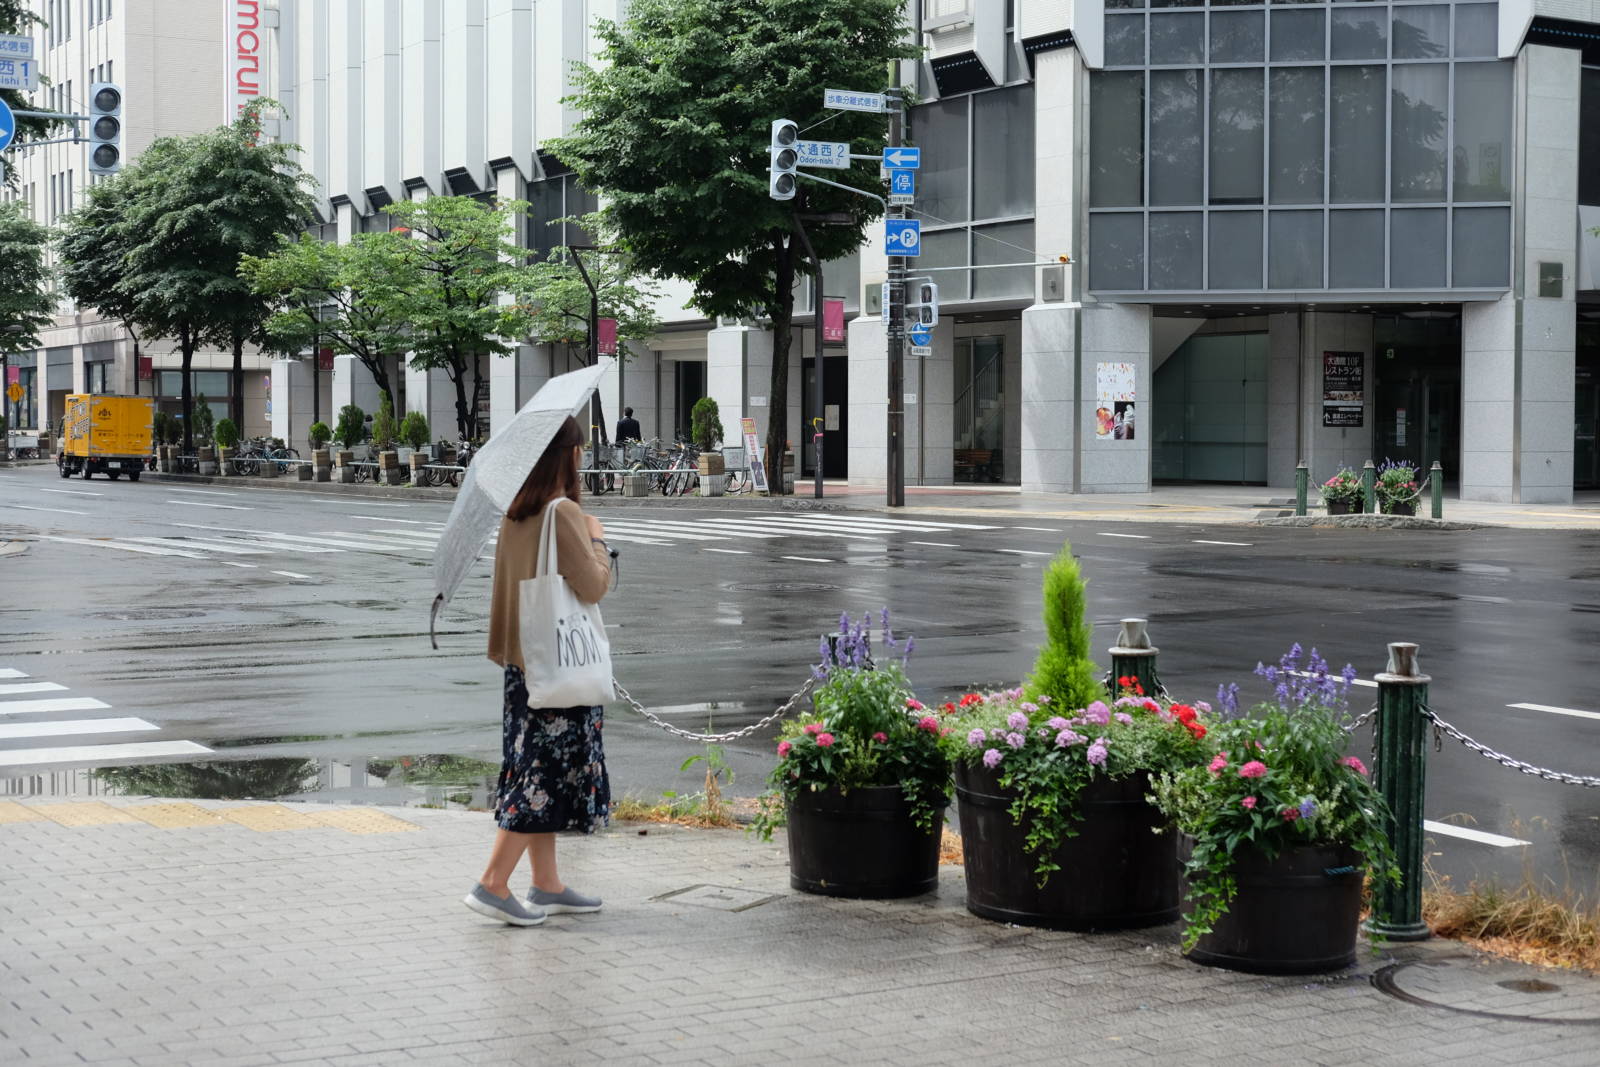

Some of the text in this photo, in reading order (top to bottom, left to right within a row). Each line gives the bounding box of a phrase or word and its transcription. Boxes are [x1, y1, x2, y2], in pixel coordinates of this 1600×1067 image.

[796, 143, 845, 158] 大通西 2
[799, 156, 834, 165] Odori-nishi
[895, 174, 911, 191] 停
[556, 626, 602, 668] MOM
